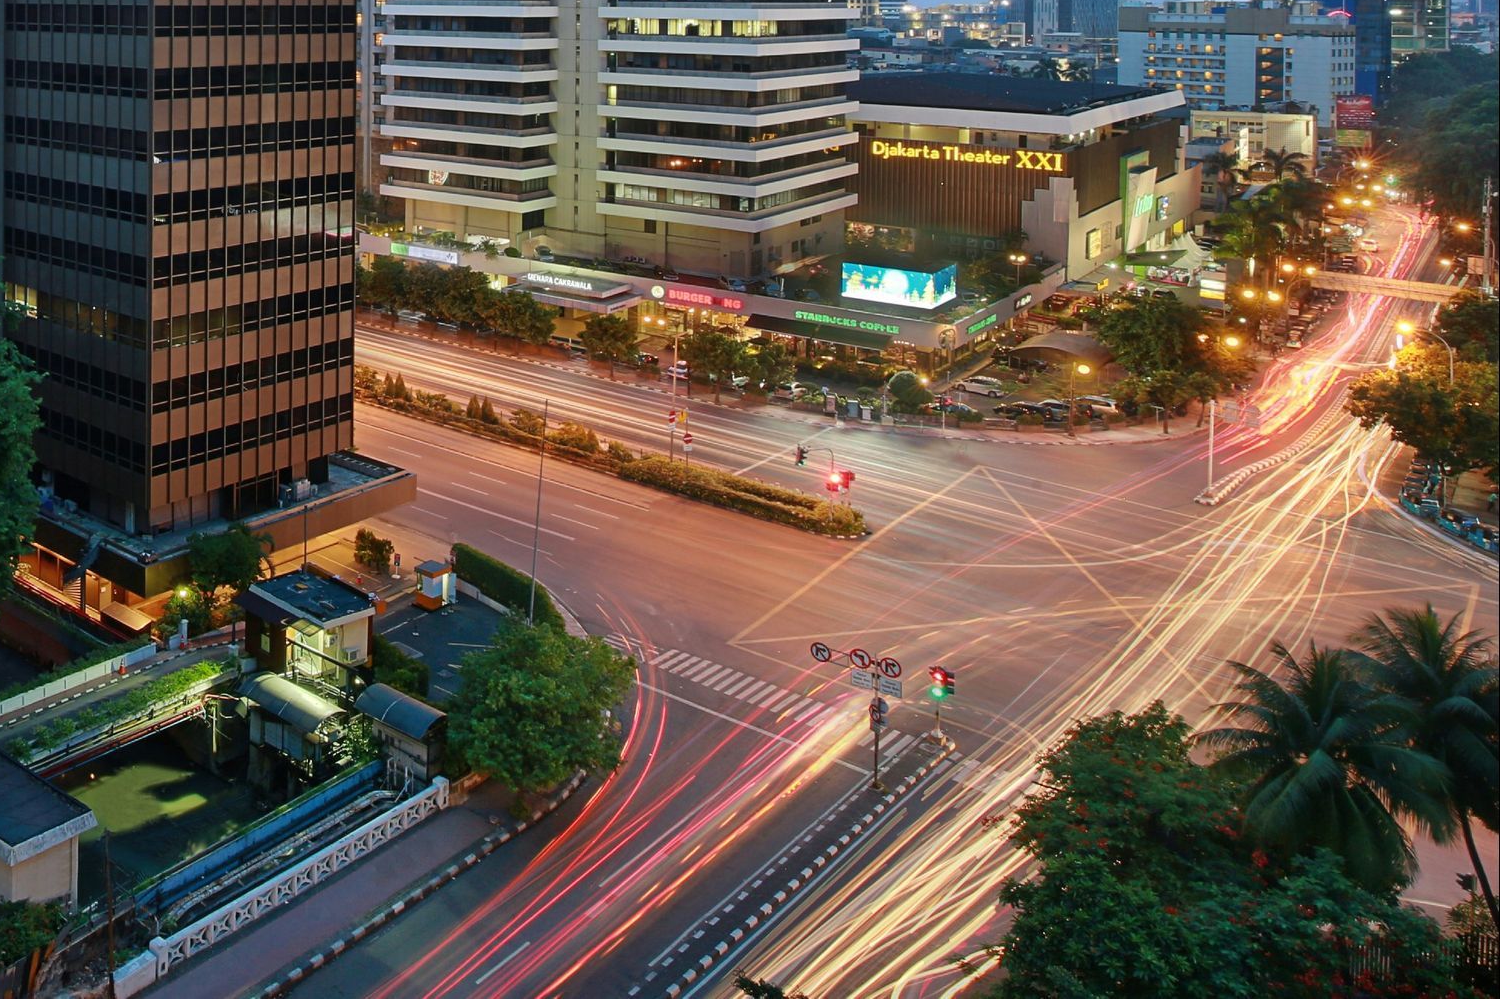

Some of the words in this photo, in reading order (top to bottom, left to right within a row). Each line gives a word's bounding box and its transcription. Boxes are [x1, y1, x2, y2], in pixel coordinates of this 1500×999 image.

[872, 141, 940, 159] Djakarta
[943, 146, 1010, 165] Theater
[1015, 150, 1064, 172] XXI
[527, 273, 553, 284] MENARA
[553, 277, 593, 291] CAKRAWALA
[668, 289, 712, 305] BURGER
[795, 310, 857, 327] STARBUCKS
[859, 321, 900, 334] COFFEE
